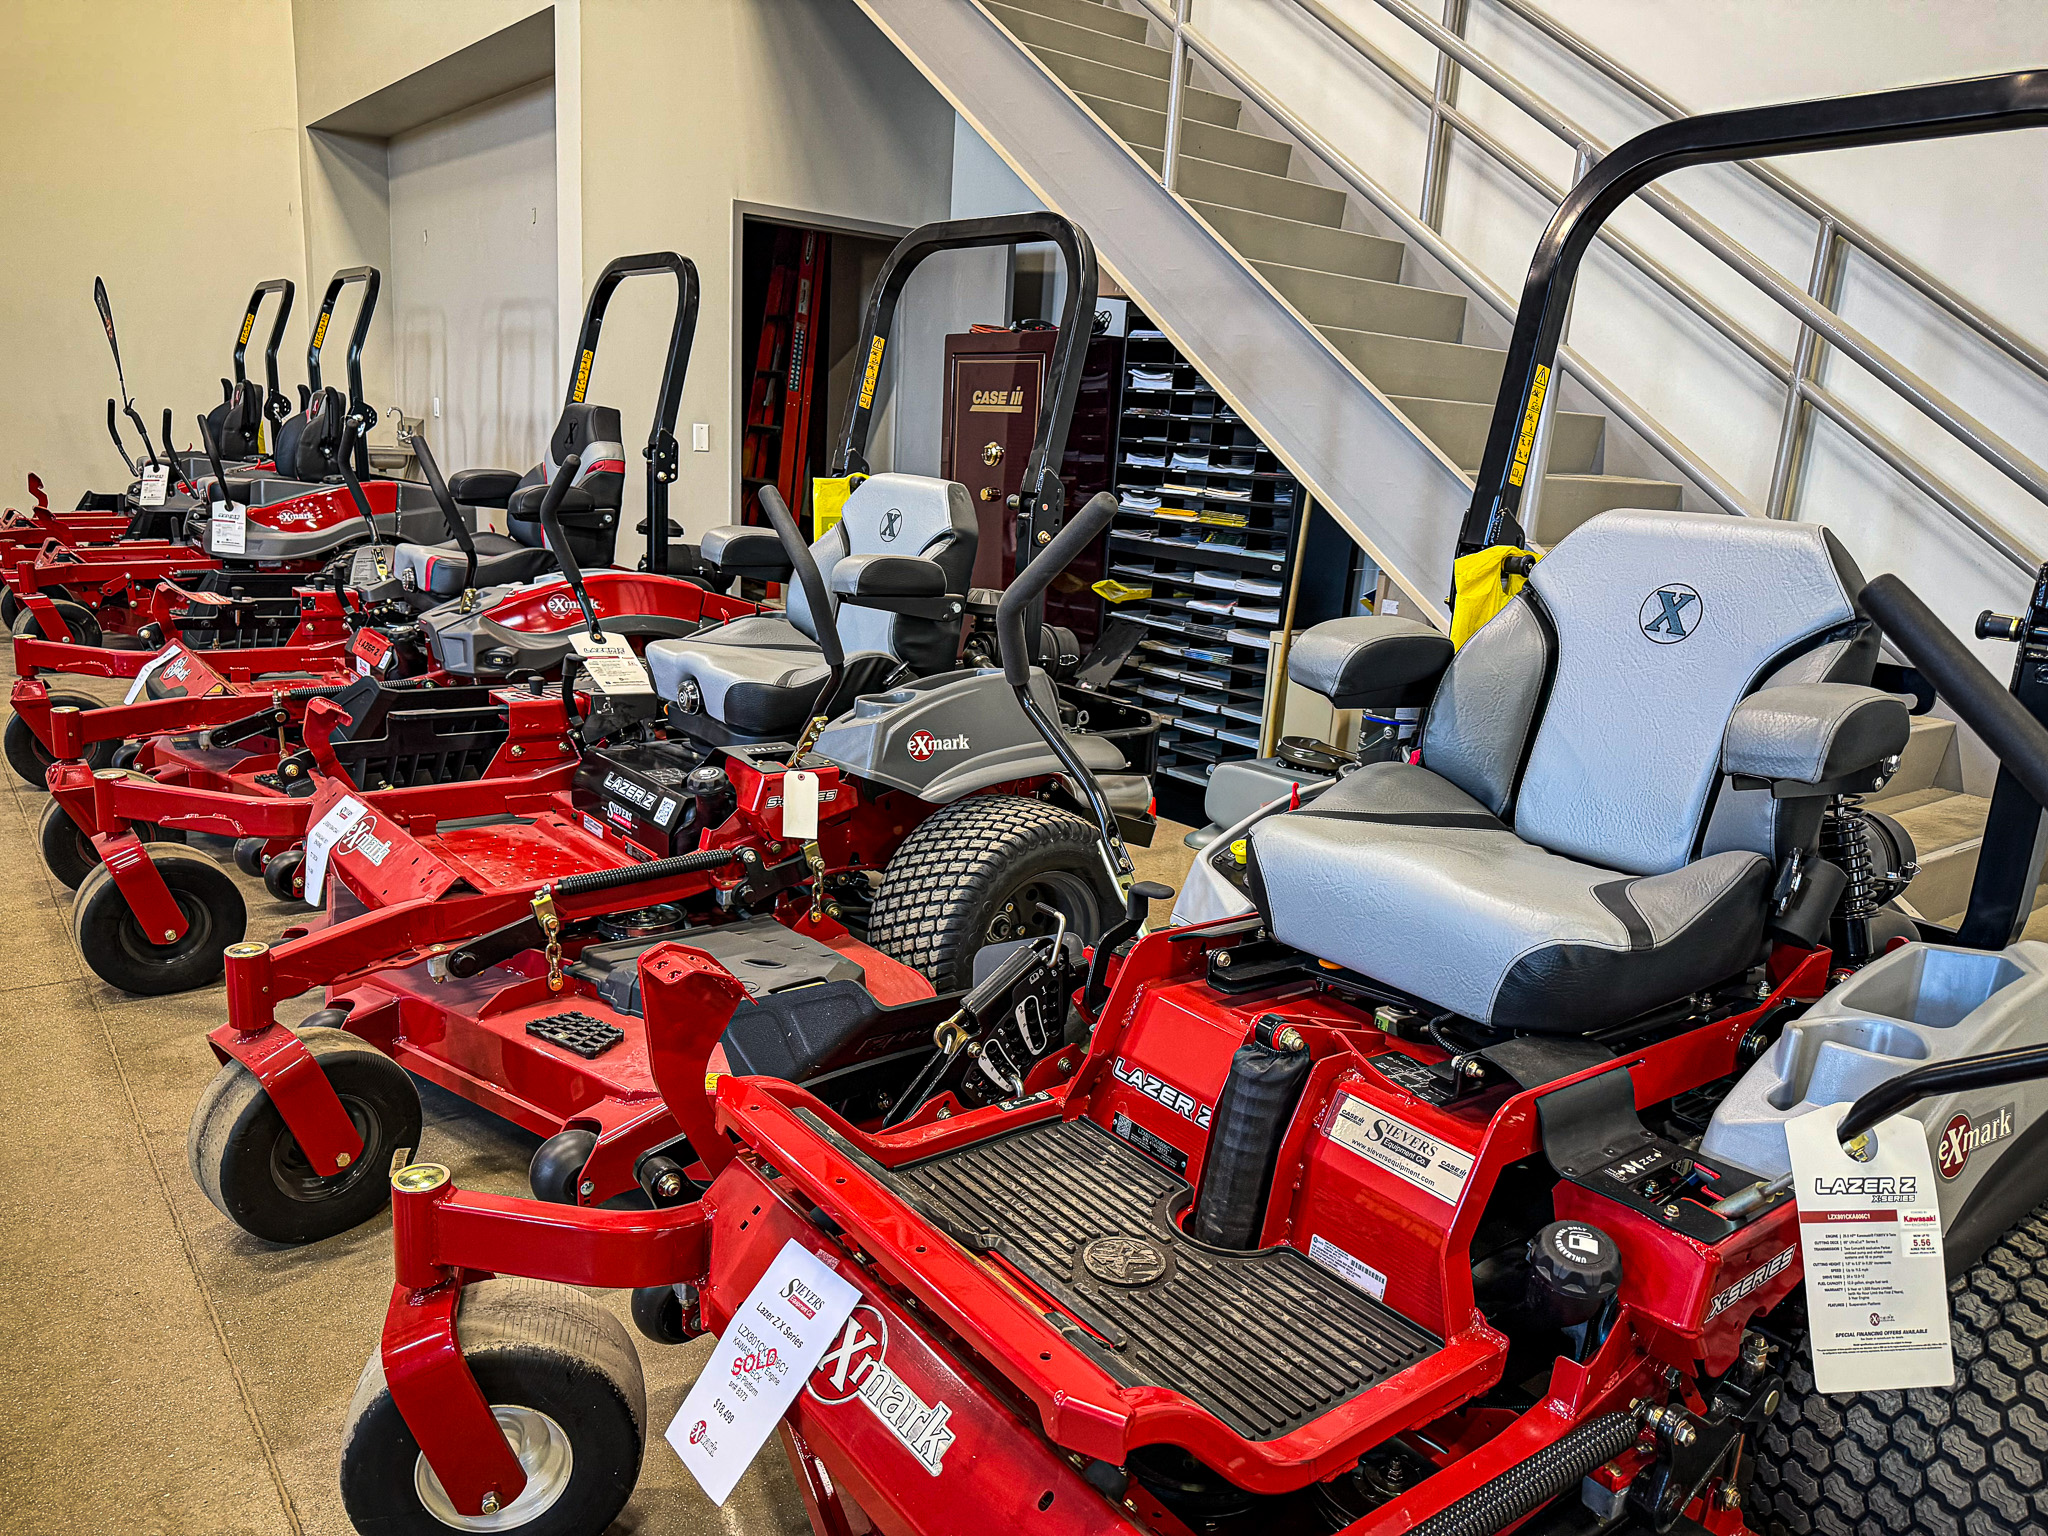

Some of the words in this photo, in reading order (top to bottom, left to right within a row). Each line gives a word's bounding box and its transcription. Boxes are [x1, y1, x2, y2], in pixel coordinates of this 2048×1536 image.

[972, 390, 1008, 405] CASE
[548, 598, 600, 612] eXmk
[906, 734, 970, 756] eXmark
[603, 772, 646, 806] LAZER
[642, 792, 658, 810] Z
[1112, 1056, 1196, 1122] LAZER
[1194, 1103, 1212, 1130] Z
[1341, 1109, 1358, 1120] CASE
[1383, 1138, 1416, 1160] Equipment
[1415, 1154, 1427, 1166] Co.
[1938, 1107, 2012, 1169] eXmark
[1352, 1139, 1436, 1187] www.sieversequipment.com
[1440, 1160, 1459, 1174] CASE
[1815, 1177, 1896, 1195] LAZER
[1899, 1176, 1916, 1194] Z
[1871, 1195, 1916, 1203] X-SERIES
[1555, 1240, 1587, 1264] UNLEADED
[778, 1278, 826, 1311] SIEVERS
[1704, 1242, 1796, 1324] X-SERIES
[756, 1302, 774, 1322] Lazer
[772, 1317, 780, 1326] Z
[777, 1322, 786, 1331] X
[783, 1327, 804, 1349] Series
[731, 1348, 778, 1376] SOLD
[816, 1313, 956, 1470] Xmark
[713, 1398, 735, 1424] $18,499
